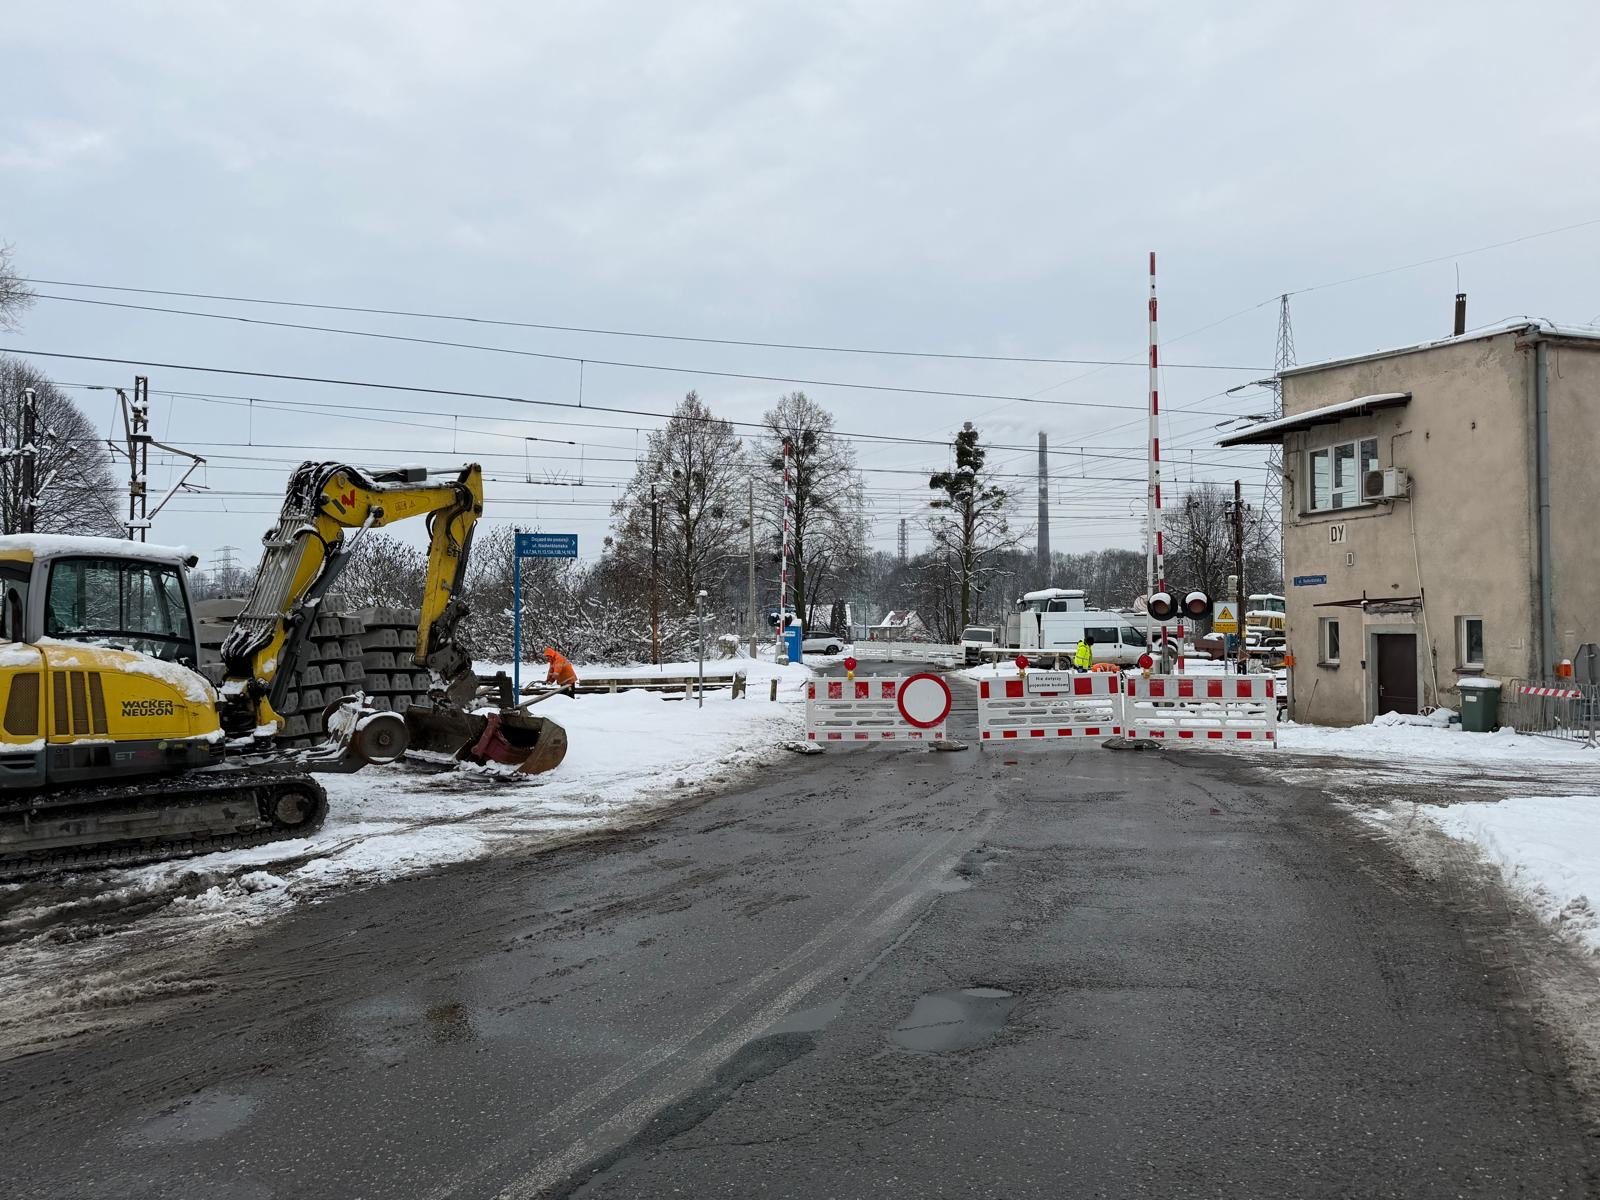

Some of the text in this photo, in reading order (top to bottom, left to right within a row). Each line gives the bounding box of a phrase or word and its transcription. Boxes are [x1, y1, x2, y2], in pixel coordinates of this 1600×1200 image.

[1331, 524, 1345, 542] DY
[121, 699, 174, 708] WACKER
[121, 708, 174, 717] NEUSON
